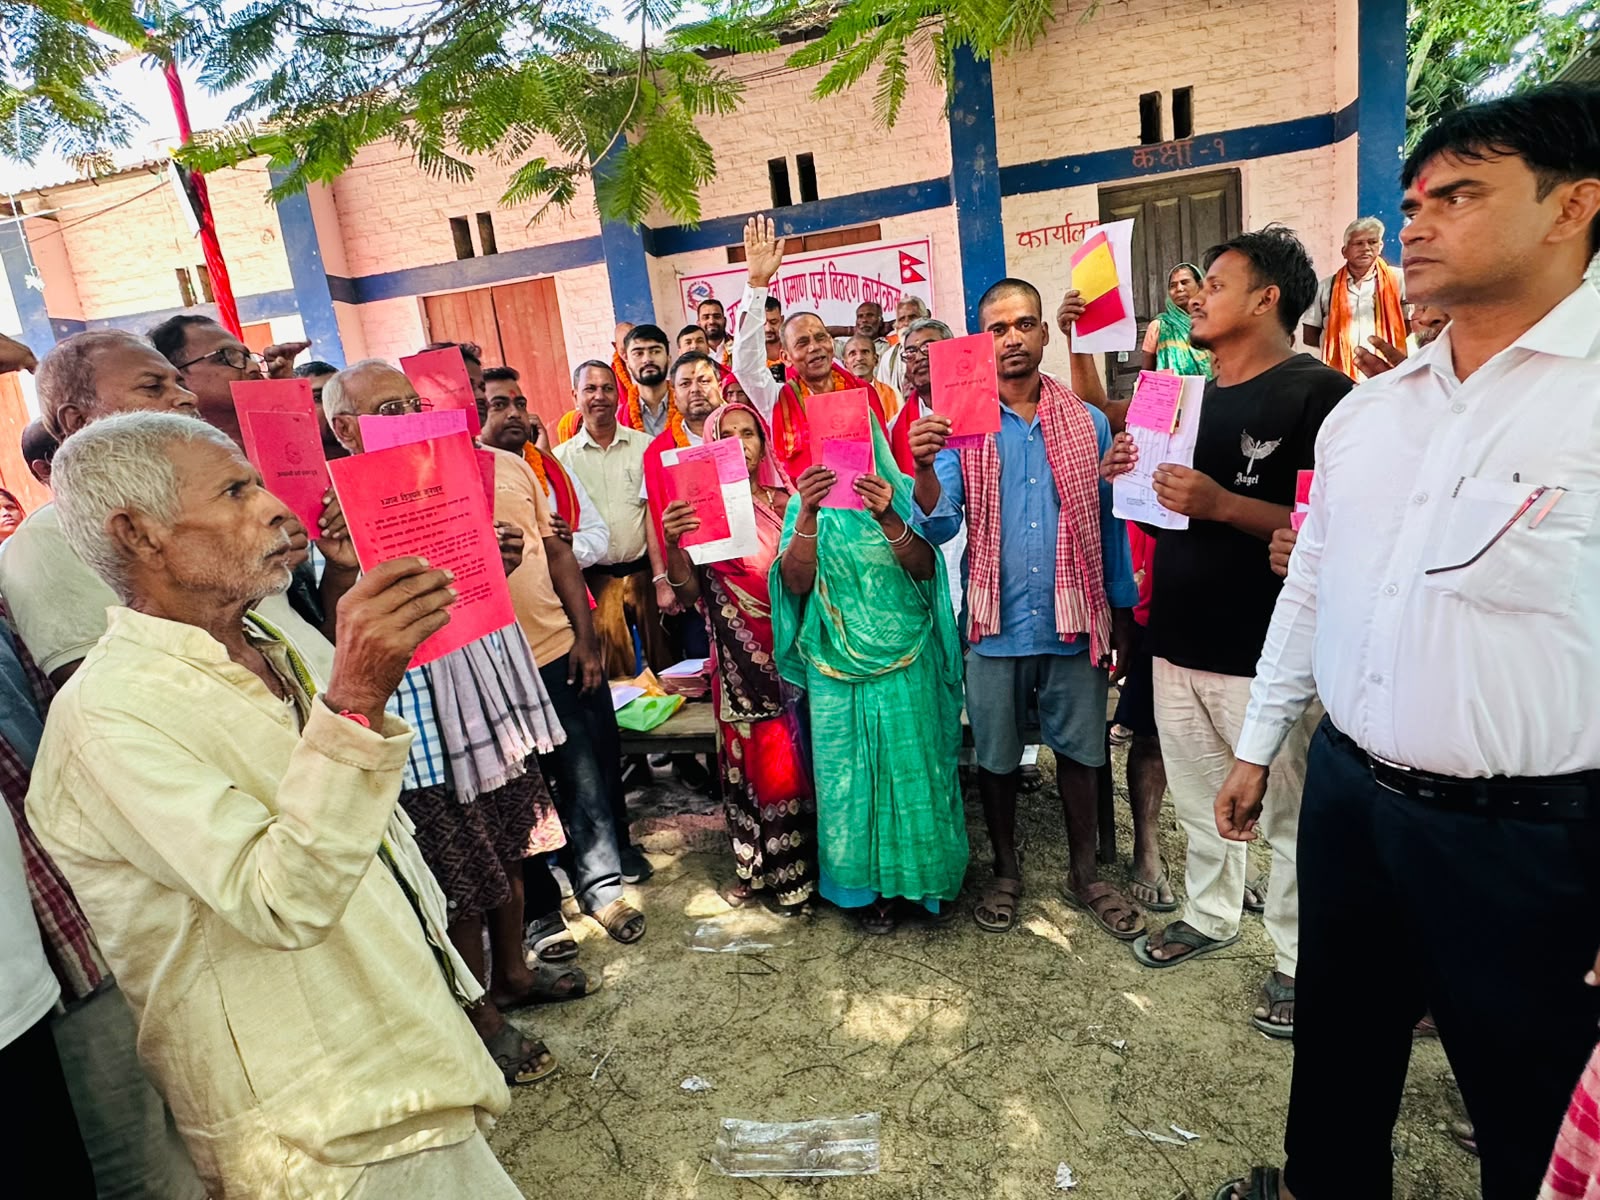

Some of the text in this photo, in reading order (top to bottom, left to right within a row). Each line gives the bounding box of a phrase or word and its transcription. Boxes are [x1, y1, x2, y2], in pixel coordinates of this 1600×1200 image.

[1132, 141, 1194, 168] कक्षा
[1016, 212, 1100, 248] कार्याल
[829, 261, 860, 303] वितरण
[1234, 472, 1259, 486] Angel
